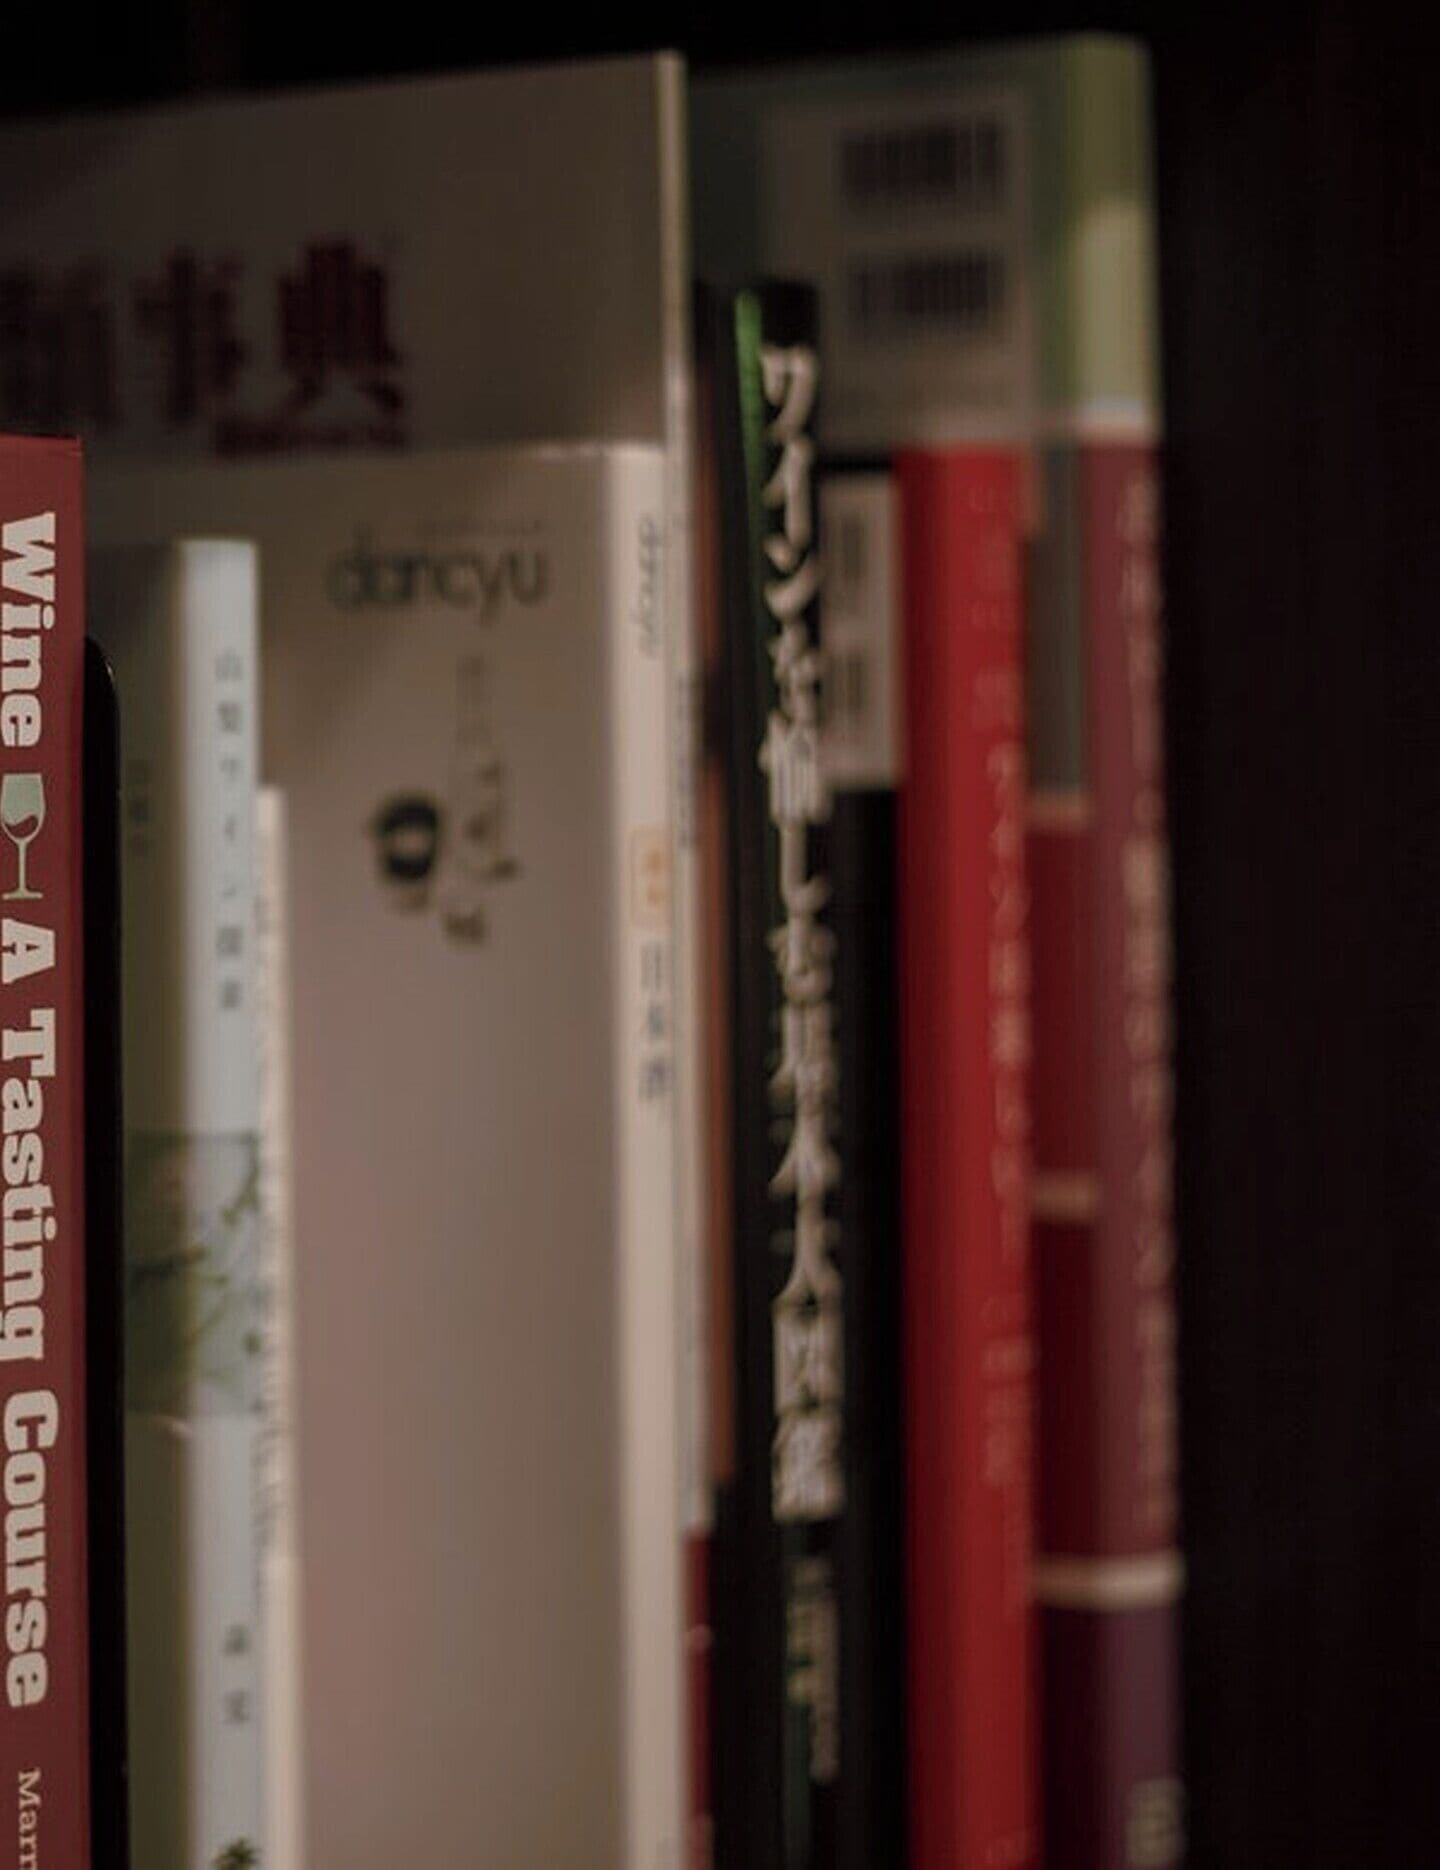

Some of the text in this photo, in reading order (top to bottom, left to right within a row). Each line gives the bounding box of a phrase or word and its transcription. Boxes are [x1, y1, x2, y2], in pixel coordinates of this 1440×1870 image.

[328, 522, 548, 630] dancyu
[1, 918, 57, 985] A
[4, 1389, 60, 1708] Course
